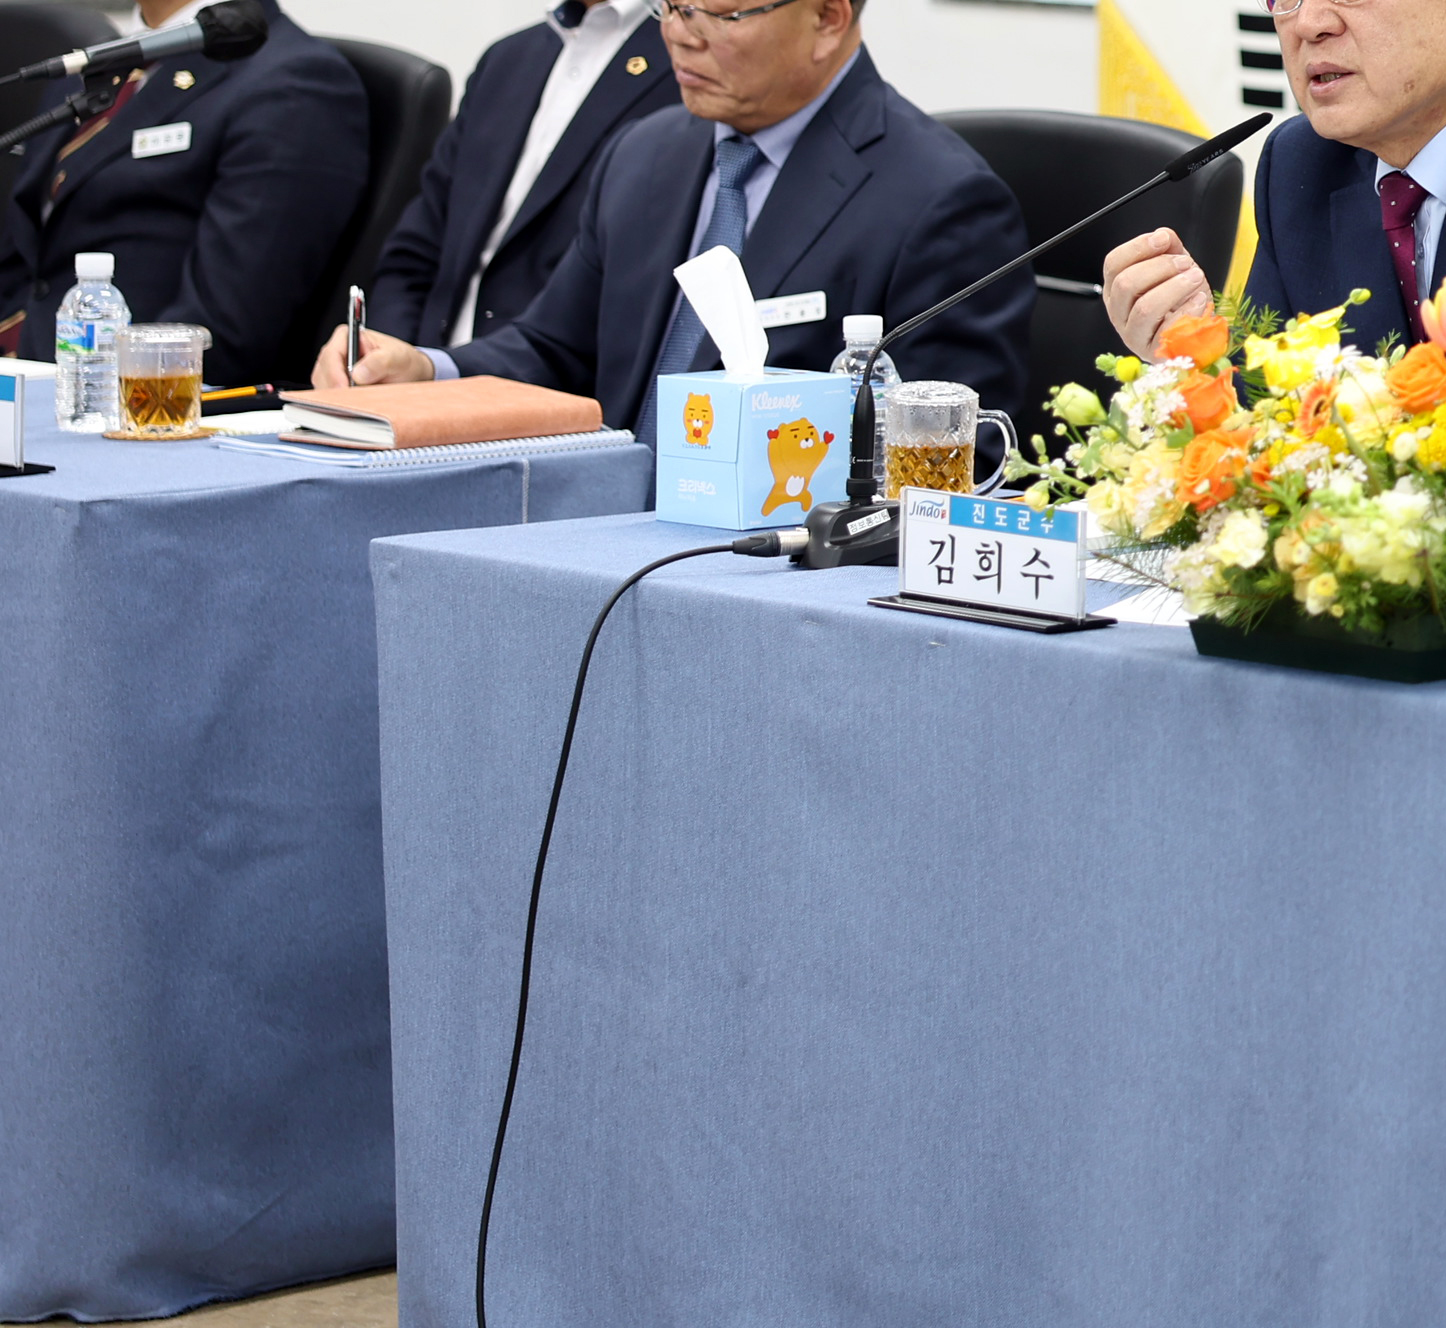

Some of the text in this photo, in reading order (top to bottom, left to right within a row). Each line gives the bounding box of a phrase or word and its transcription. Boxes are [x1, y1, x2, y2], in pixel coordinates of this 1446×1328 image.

[751, 391, 803, 412] Kleenex
[909, 500, 942, 519] Jindo
[849, 510, 889, 534] 정보통신팀
